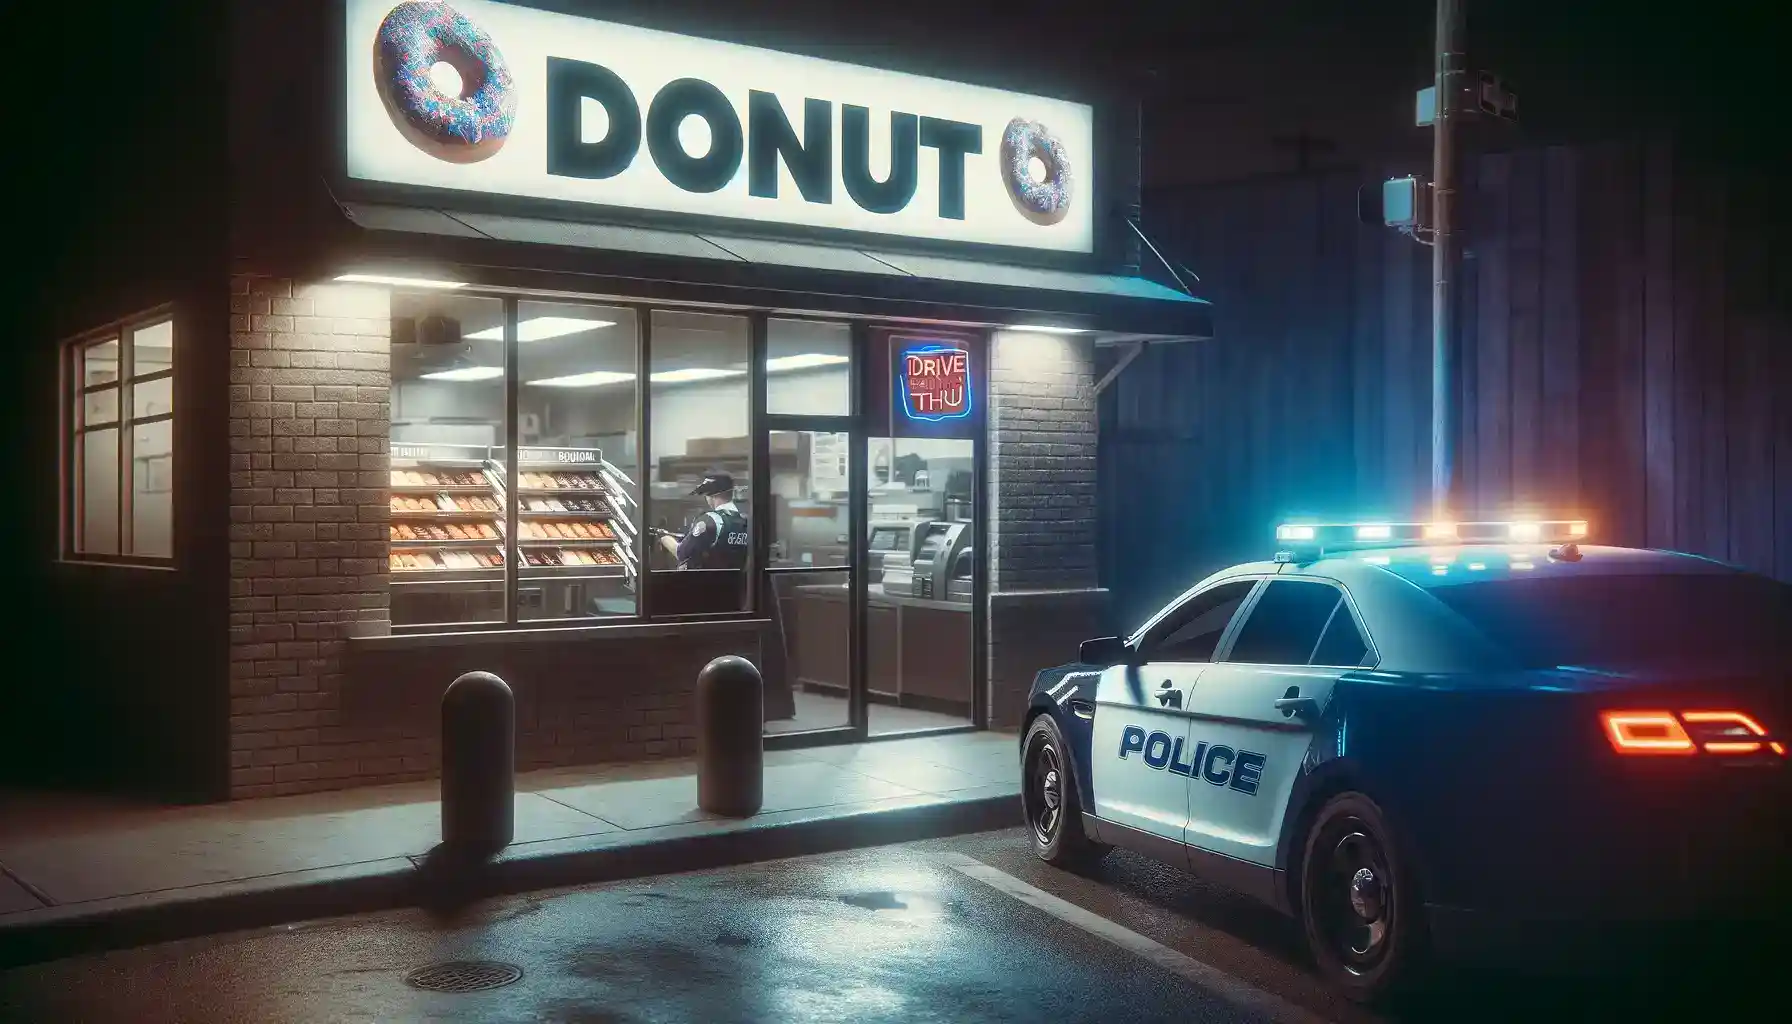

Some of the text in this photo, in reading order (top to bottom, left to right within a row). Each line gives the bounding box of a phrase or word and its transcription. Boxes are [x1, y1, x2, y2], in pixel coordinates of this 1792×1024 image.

[547, 56, 982, 221] DONUT
[906, 355, 966, 376] DRIVE
[1118, 724, 1267, 796] POLICE
